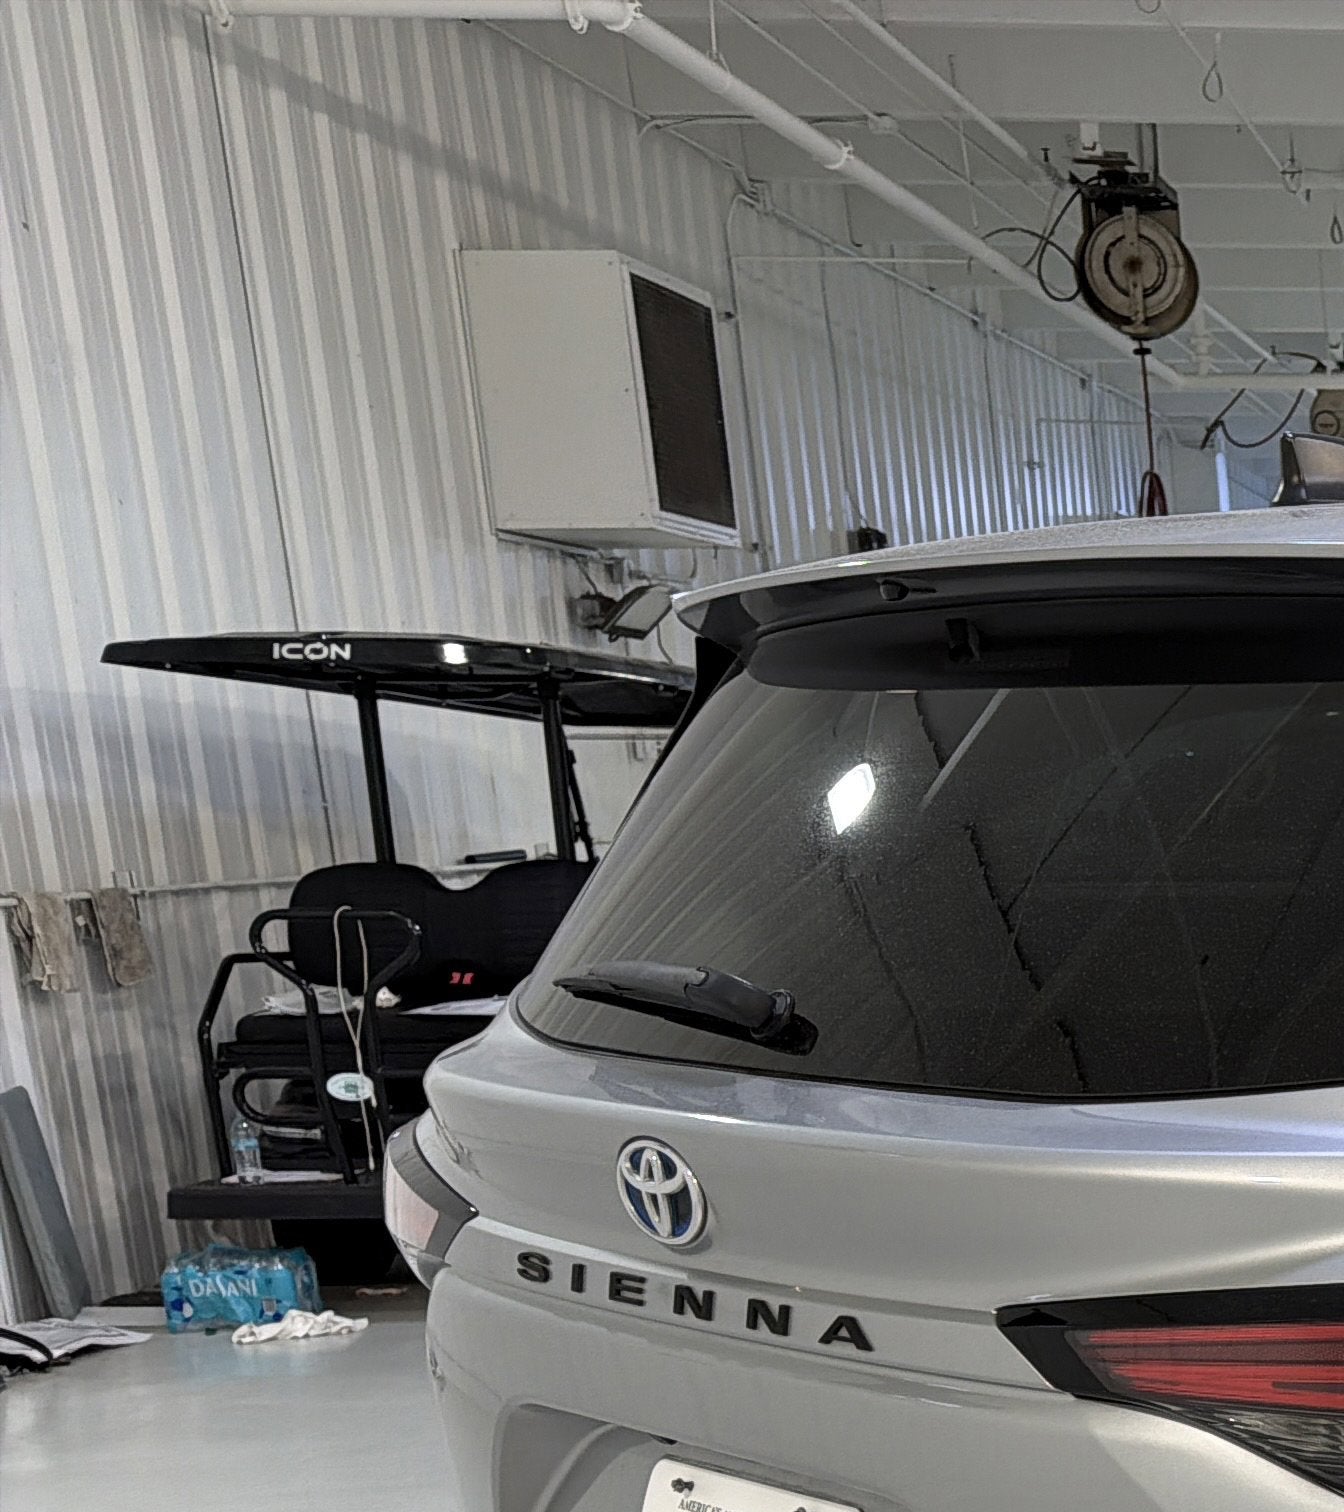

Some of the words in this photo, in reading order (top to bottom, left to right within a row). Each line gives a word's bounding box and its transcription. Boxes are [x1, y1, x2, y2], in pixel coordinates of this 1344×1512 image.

[272, 641, 352, 661] ICON
[188, 1273, 259, 1299] DASANI
[516, 1251, 876, 1353] SIENNA
